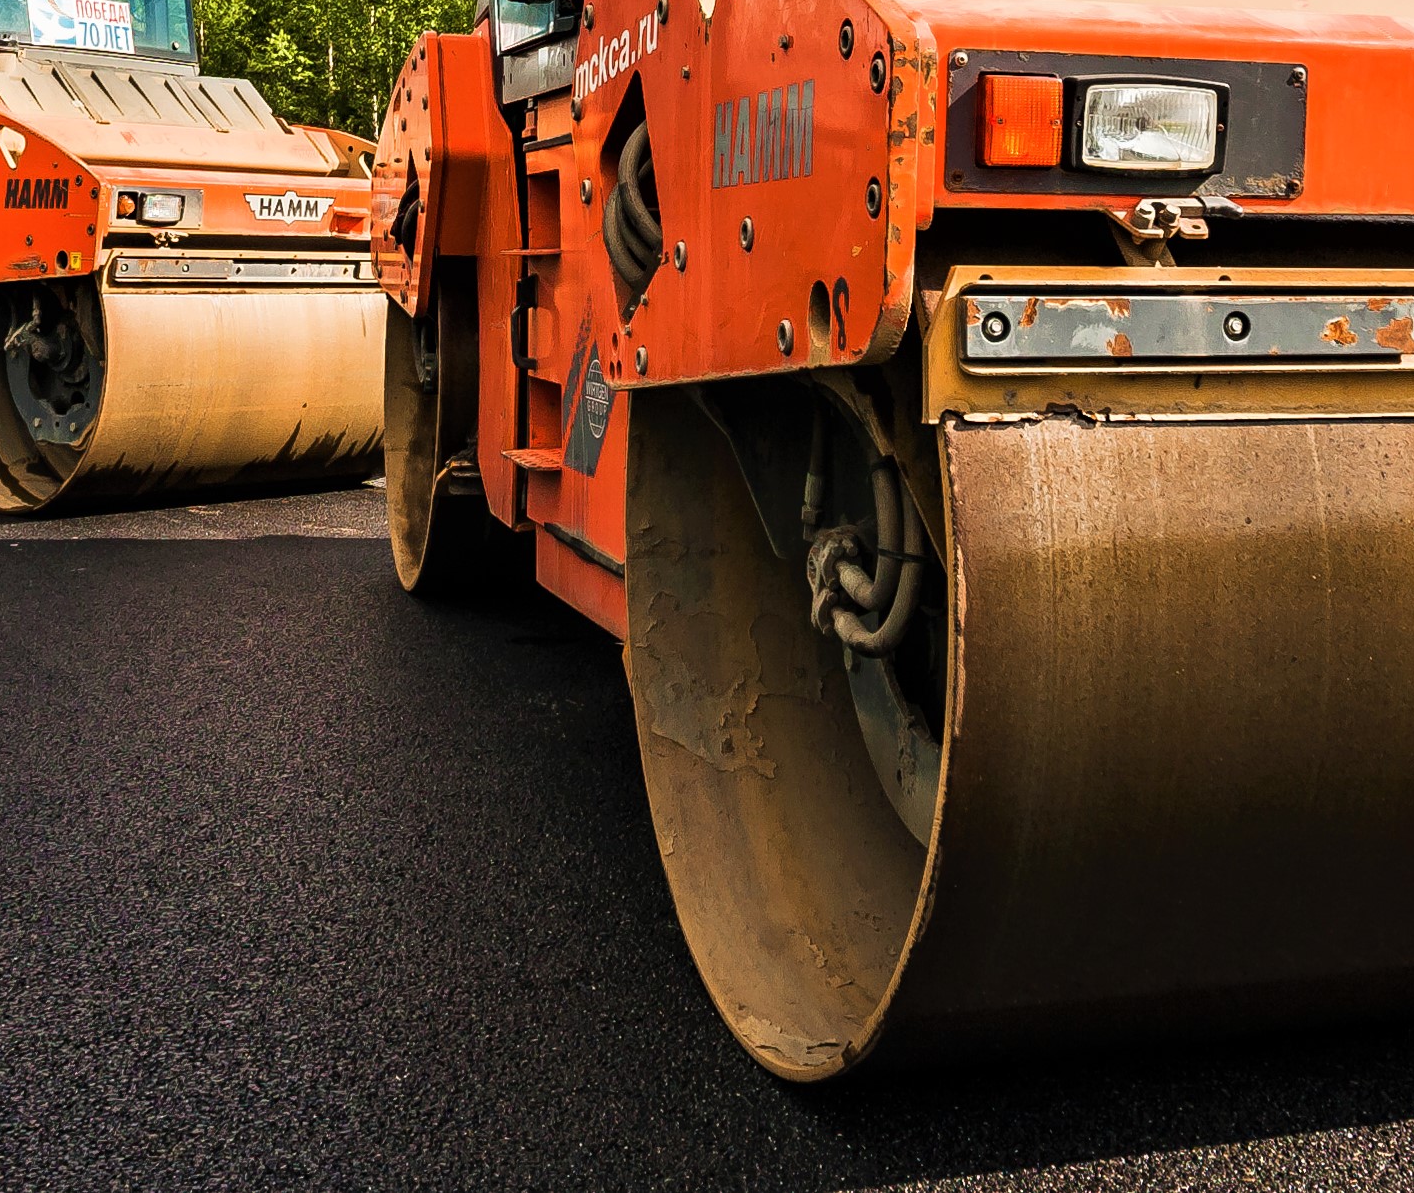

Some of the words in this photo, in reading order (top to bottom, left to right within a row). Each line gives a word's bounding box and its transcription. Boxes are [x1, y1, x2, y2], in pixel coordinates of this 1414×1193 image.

[75, 0, 129, 24] ПОБЕДА!
[79, 21, 101, 47] 70
[104, 24, 130, 51] ЛЕТ
[575, 9, 658, 100] mckca.ru
[712, 78, 814, 189] HAMM
[4, 178, 69, 209] HAMM
[259, 198, 318, 217] HAMM
